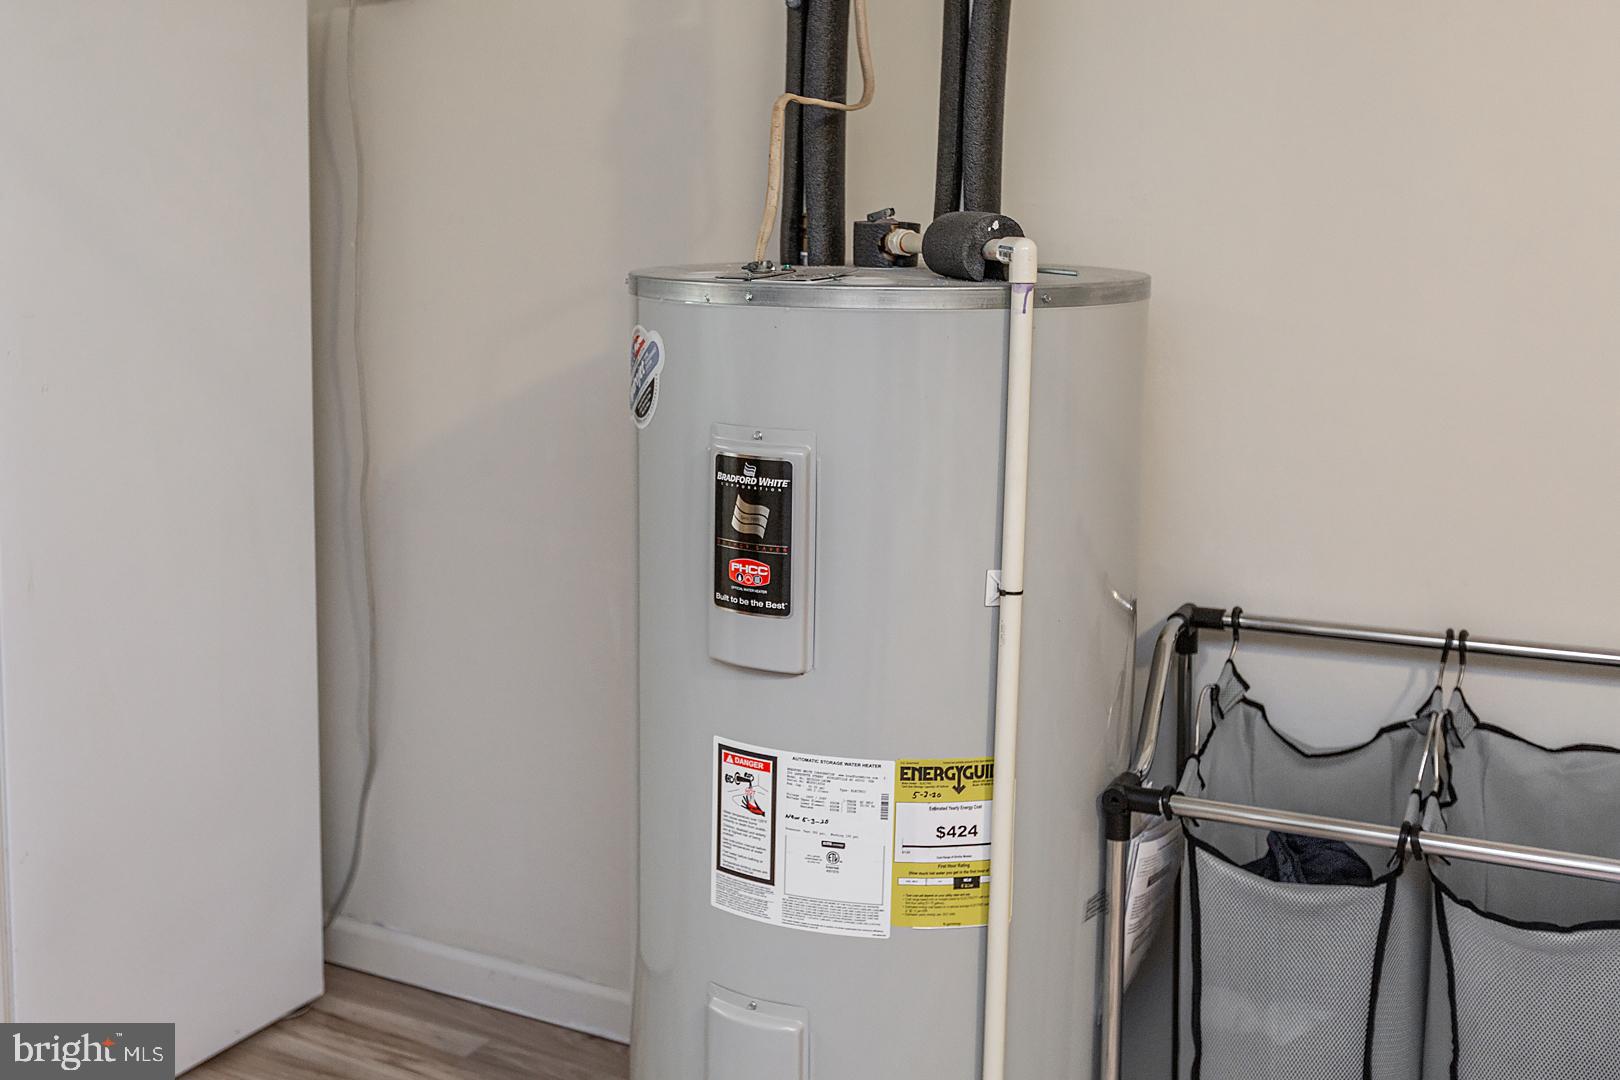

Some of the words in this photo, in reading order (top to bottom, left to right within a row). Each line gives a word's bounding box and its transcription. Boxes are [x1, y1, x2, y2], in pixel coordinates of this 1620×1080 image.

[717, 472, 757, 485] BRADFORD
[759, 478, 790, 488] WHITE
[731, 562, 768, 576] PHCC
[716, 592, 729, 602] Built
[739, 597, 749, 605] be
[750, 599, 764, 608] the
[734, 756, 764, 769] DANGER
[792, 756, 819, 764] AUTOMATIC
[936, 825, 978, 840] $424
